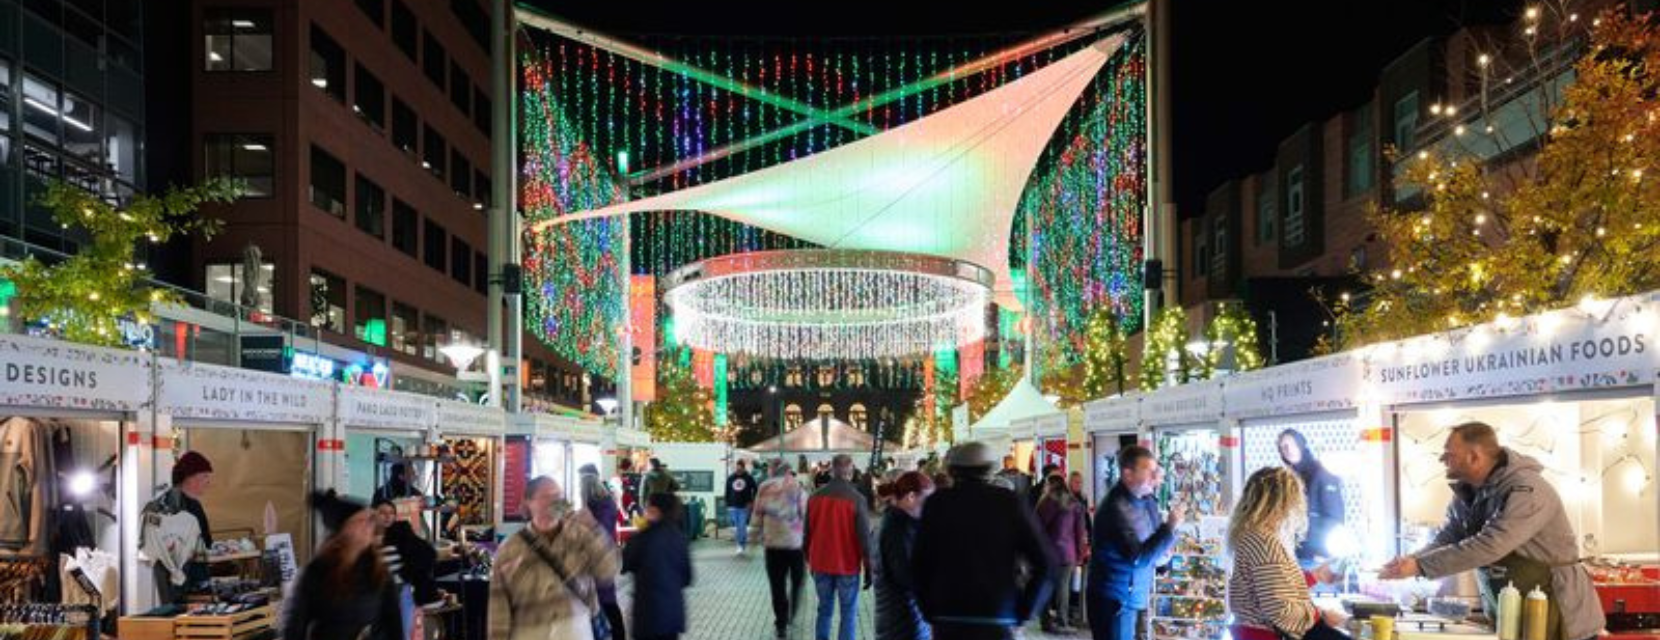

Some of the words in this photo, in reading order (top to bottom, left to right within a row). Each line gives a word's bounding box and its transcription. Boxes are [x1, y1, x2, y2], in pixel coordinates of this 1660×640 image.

[1381, 359, 1460, 383] SUNFLOWER
[1464, 344, 1563, 373] UKRAINIAN
[1570, 333, 1646, 359] FOODS
[6, 362, 97, 389] DESIGNS
[202, 385, 236, 401] LADY
[240, 389, 254, 403] IN
[257, 390, 278, 406] THE
[282, 393, 307, 408] WILD
[1277, 380, 1312, 398] PRINTS
